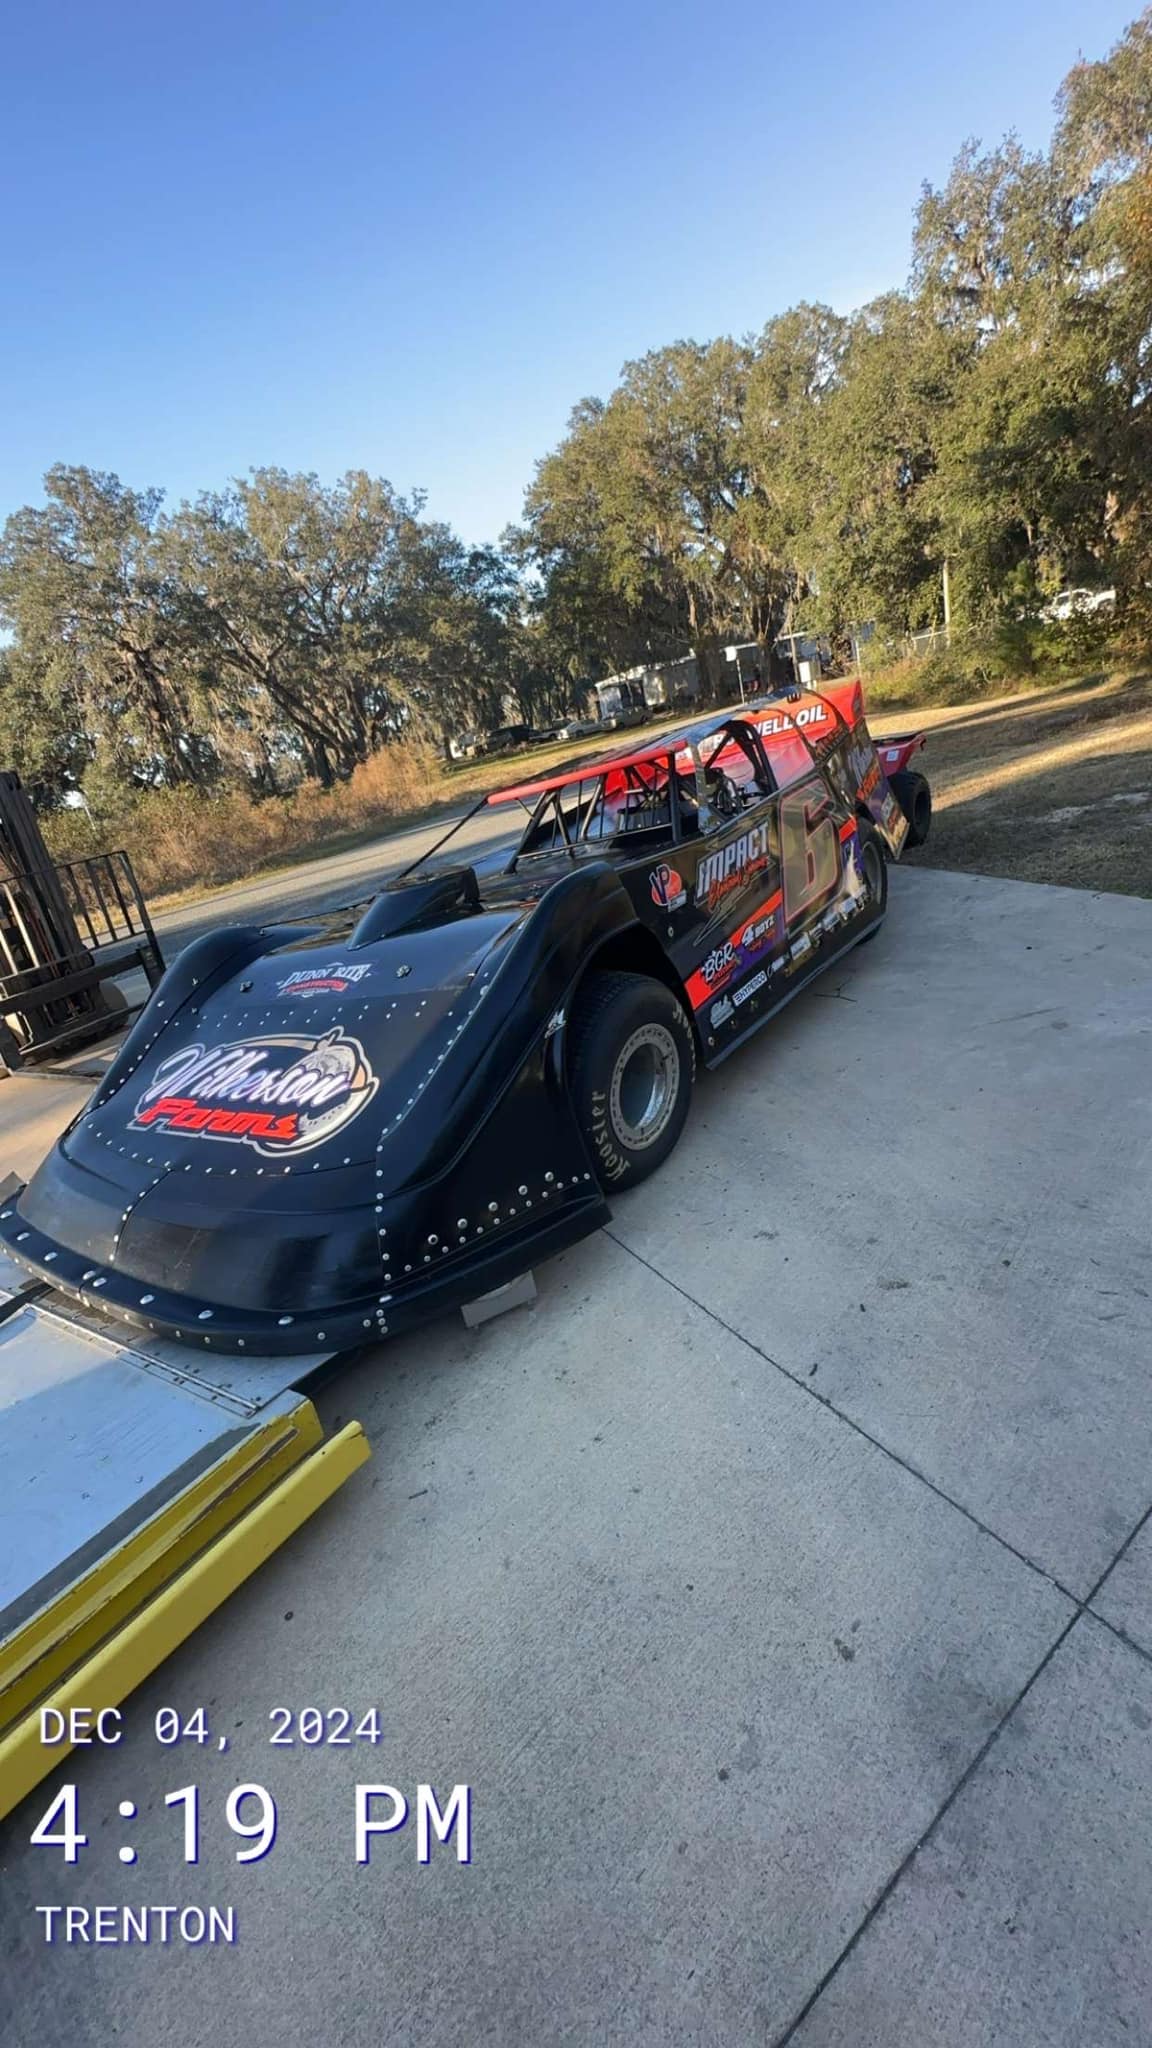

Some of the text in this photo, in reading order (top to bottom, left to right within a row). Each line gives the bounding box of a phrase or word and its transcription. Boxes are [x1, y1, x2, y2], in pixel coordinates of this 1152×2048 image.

[796, 704, 827, 727] OIL
[696, 822, 769, 900] IMPACT
[780, 777, 840, 922] 6
[741, 923, 756, 947] 4
[702, 941, 736, 983] BGR
[144, 1048, 352, 1107] Wilkerson
